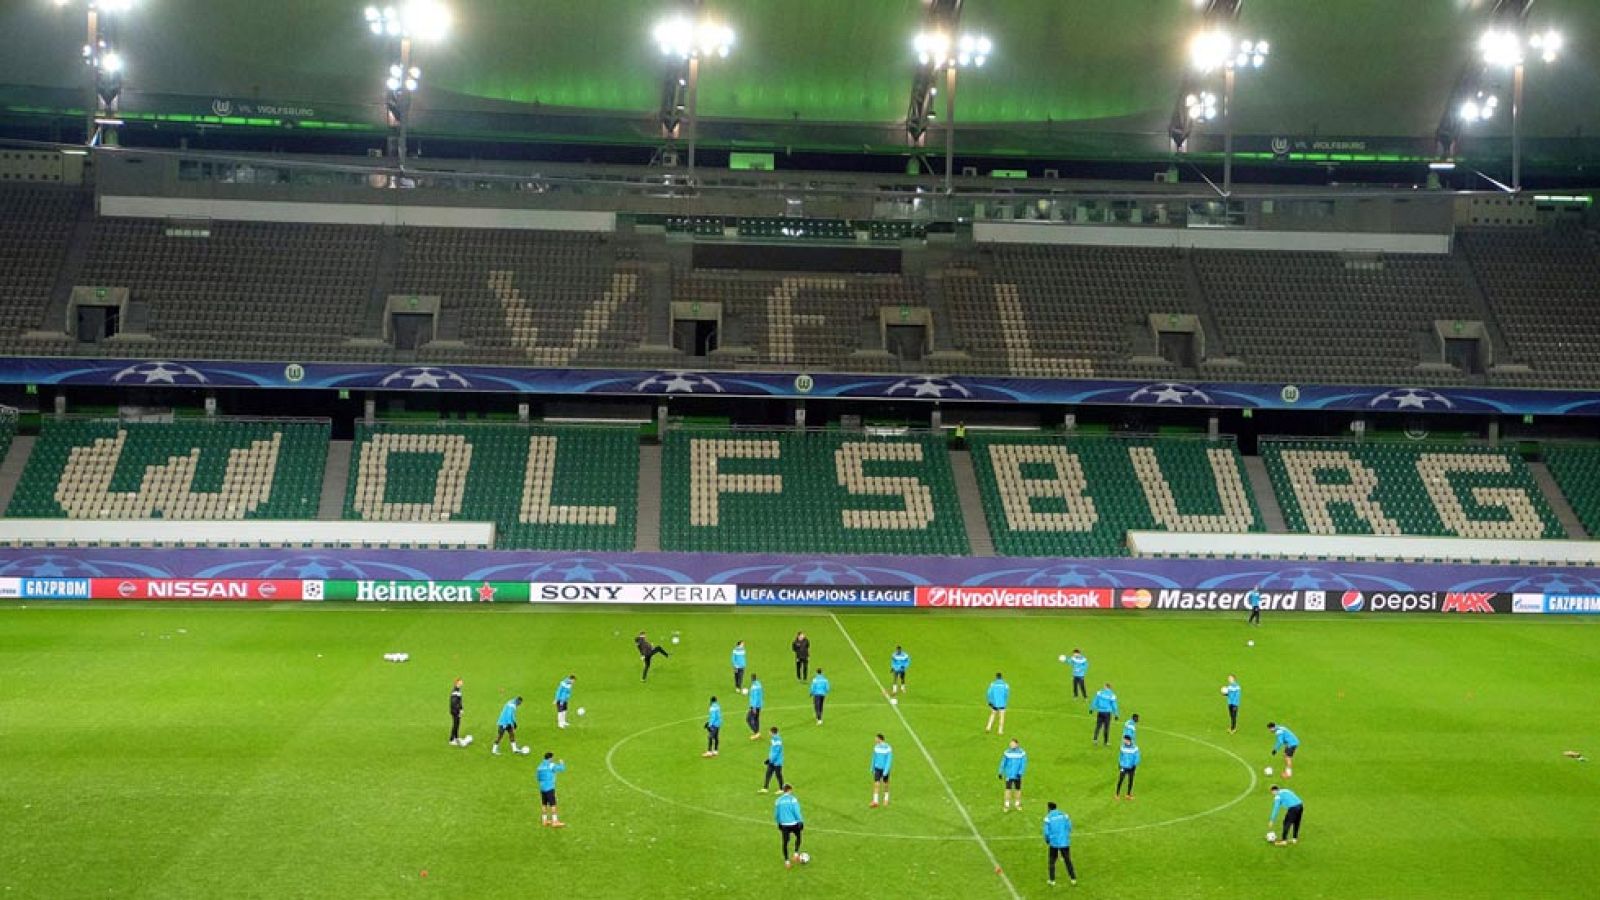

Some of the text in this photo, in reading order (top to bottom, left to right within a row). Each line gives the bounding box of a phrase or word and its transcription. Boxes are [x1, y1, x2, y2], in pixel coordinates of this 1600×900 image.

[54, 429, 1546, 539] WOLFSBURG
[26, 580, 87, 596] GAZPROM
[147, 581, 248, 597] NISSAN
[356, 580, 474, 602] Heineken
[541, 585, 728, 601] SONY XPERIA
[740, 589, 912, 602] UEFA CHAMPIONS LEAGUE
[948, 589, 1101, 608] HypoVereinsbank
[1370, 591, 1497, 612] pepsi MAX
